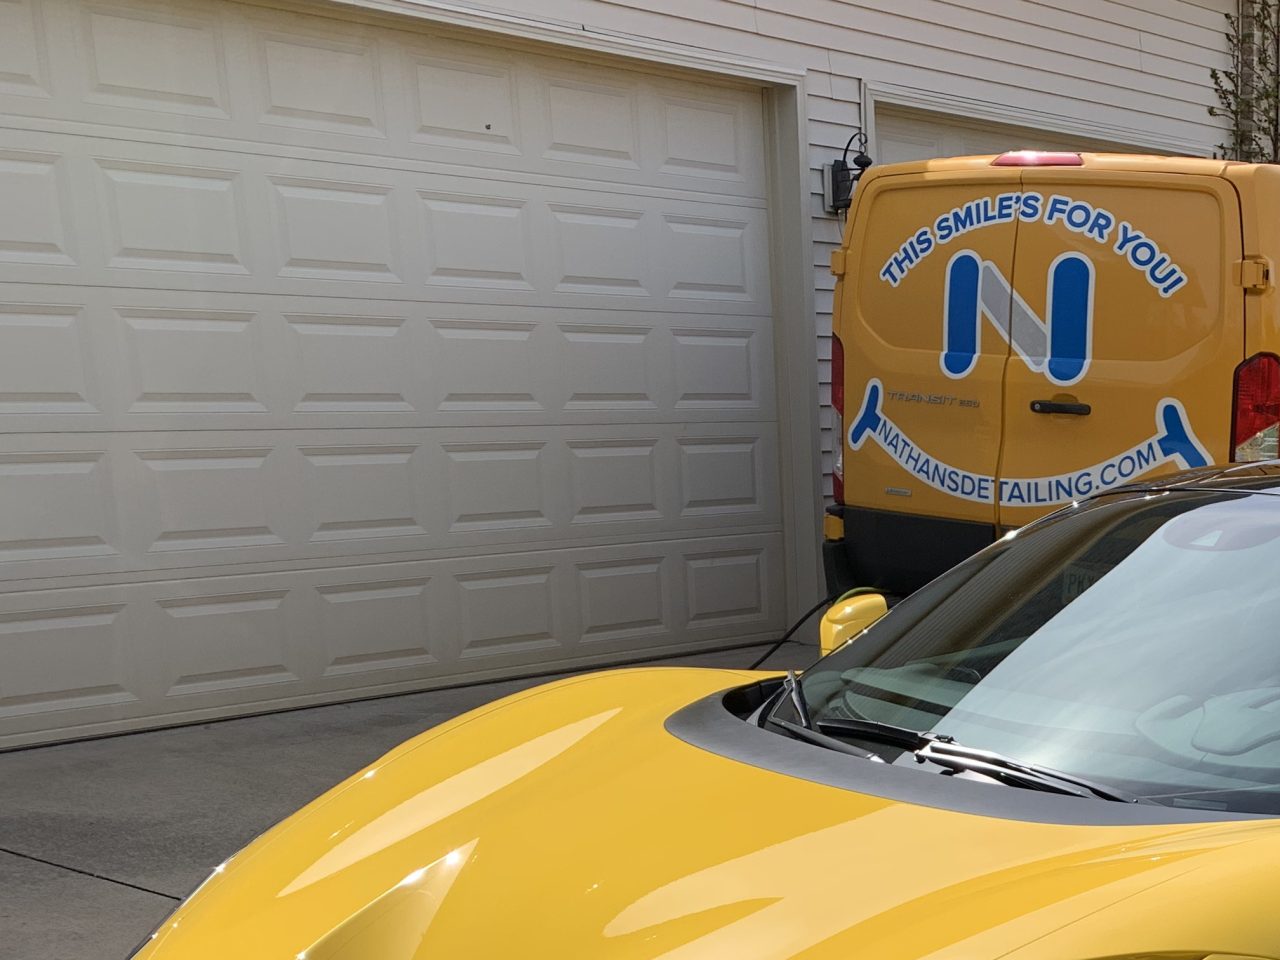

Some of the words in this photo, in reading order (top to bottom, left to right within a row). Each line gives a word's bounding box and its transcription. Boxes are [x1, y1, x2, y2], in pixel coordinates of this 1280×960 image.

[881, 230, 933, 285] THIS
[938, 194, 1040, 241] SMILE'S
[1047, 198, 1112, 240] FOR
[1117, 224, 1184, 294] YOU!
[944, 254, 1091, 382] N
[887, 391, 958, 406] TRANSIT
[878, 417, 1157, 503] NATHANSDETAILING.COM
